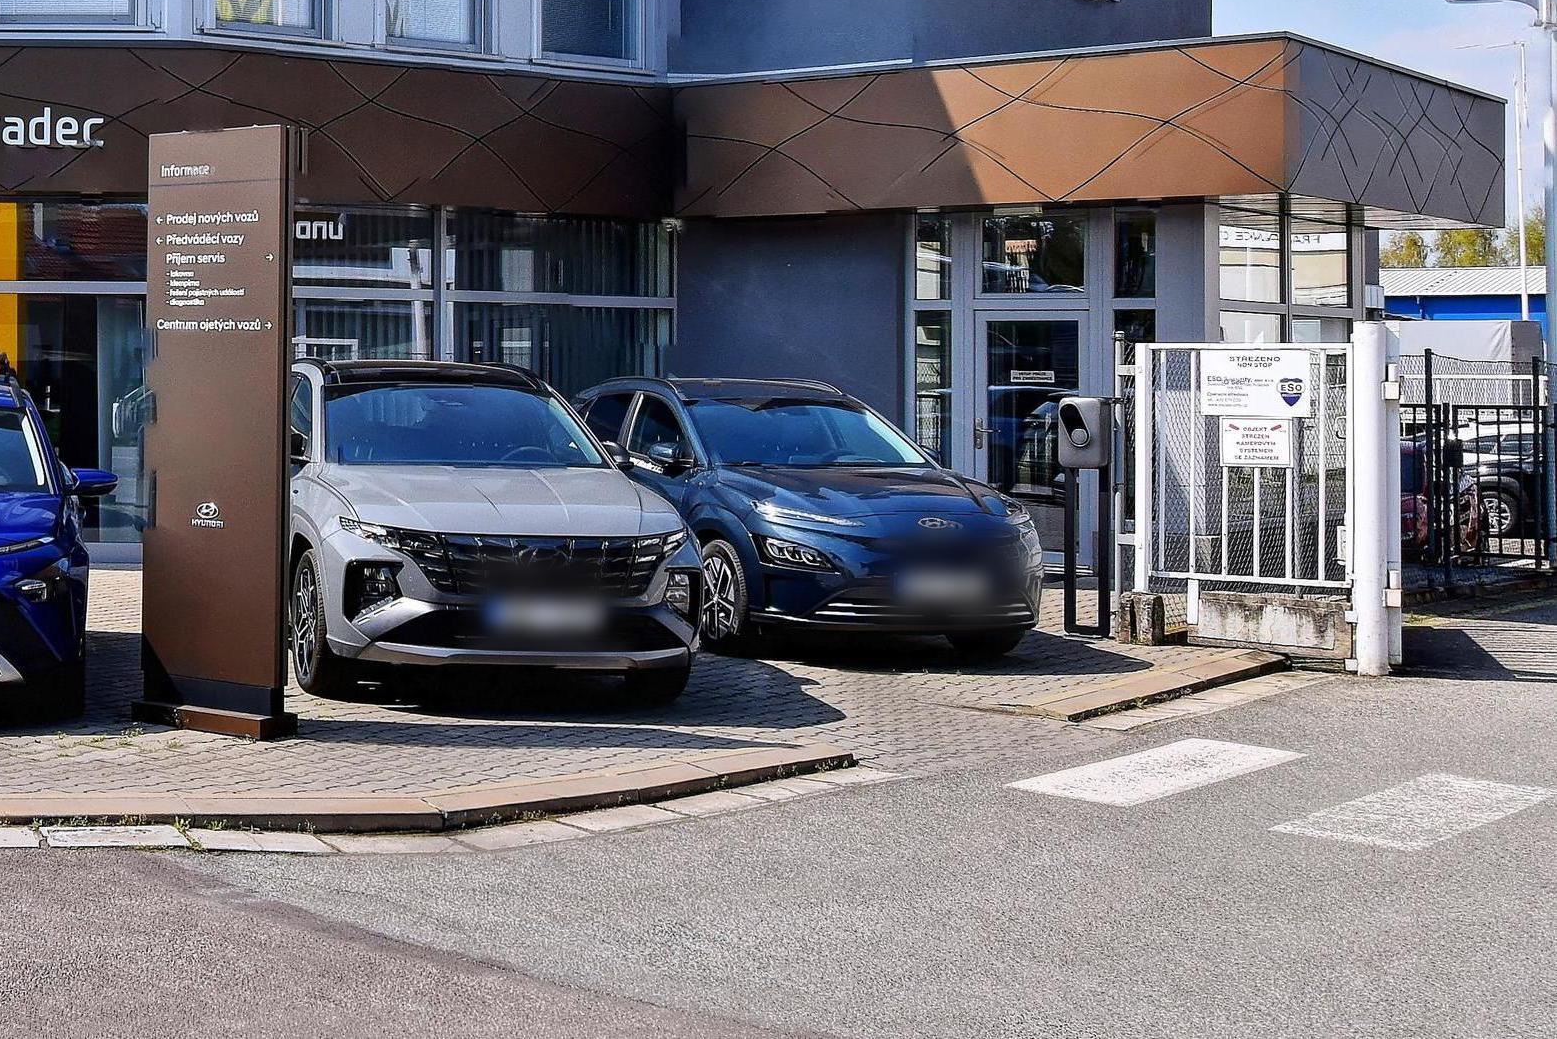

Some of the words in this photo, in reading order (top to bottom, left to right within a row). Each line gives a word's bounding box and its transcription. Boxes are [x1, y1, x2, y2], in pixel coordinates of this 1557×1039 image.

[161, 164, 210, 178] Informace
[166, 212, 197, 226] Prodej
[198, 211, 233, 225] nových
[235, 209, 259, 222] vozů
[166, 231, 220, 245] Předváděcí
[221, 234, 245, 245] vozy
[197, 252, 226, 263] servis
[156, 318, 198, 330] Centrum
[199, 318, 235, 332] ojetých
[236, 318, 261, 330] vozů
[1280, 383, 1303, 392] ESO
[191, 518, 224, 529] HYUNDAI
